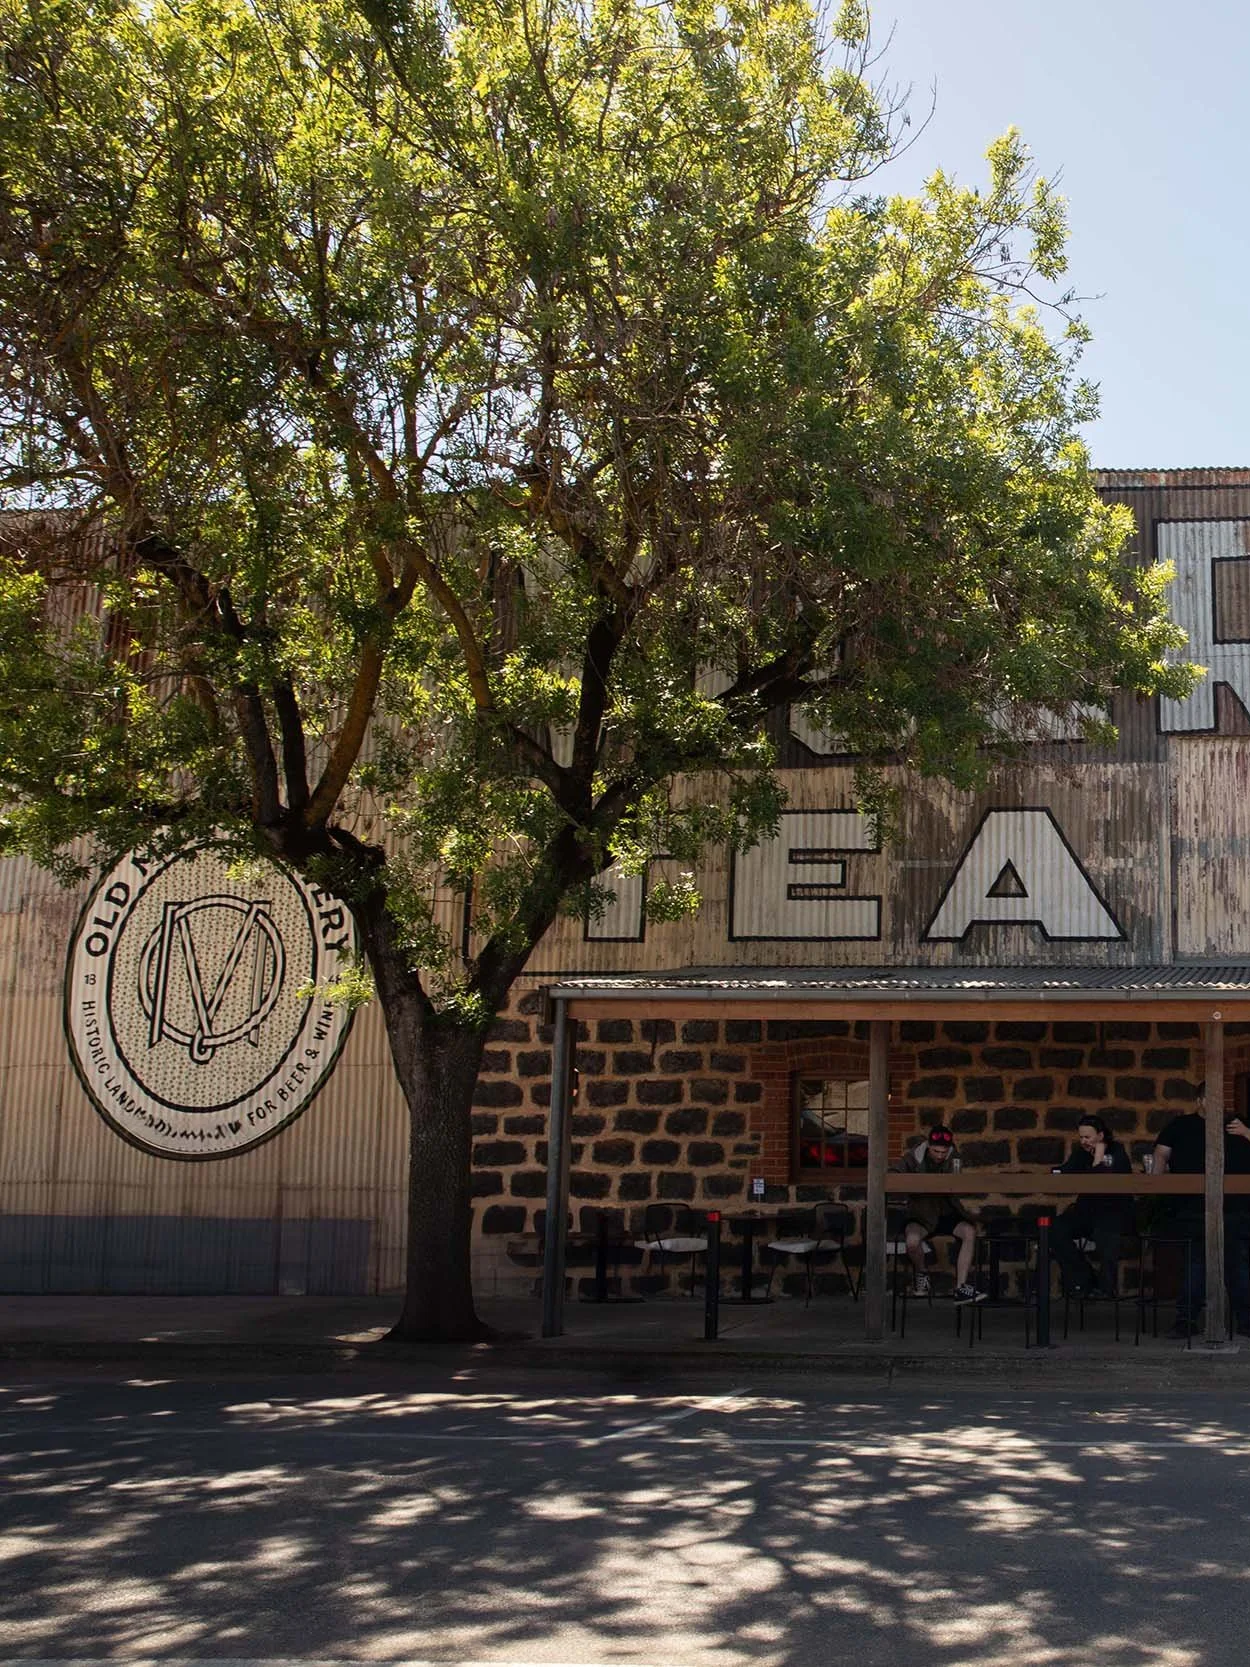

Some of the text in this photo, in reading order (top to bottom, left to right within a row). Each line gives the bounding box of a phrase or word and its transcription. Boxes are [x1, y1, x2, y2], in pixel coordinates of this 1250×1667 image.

[85, 881, 130, 957] OLD
[82, 1000, 111, 1074] HISTORIC
[247, 1100, 278, 1126] FOR
[277, 1062, 310, 1102] BEER
[305, 1048, 320, 1059] &
